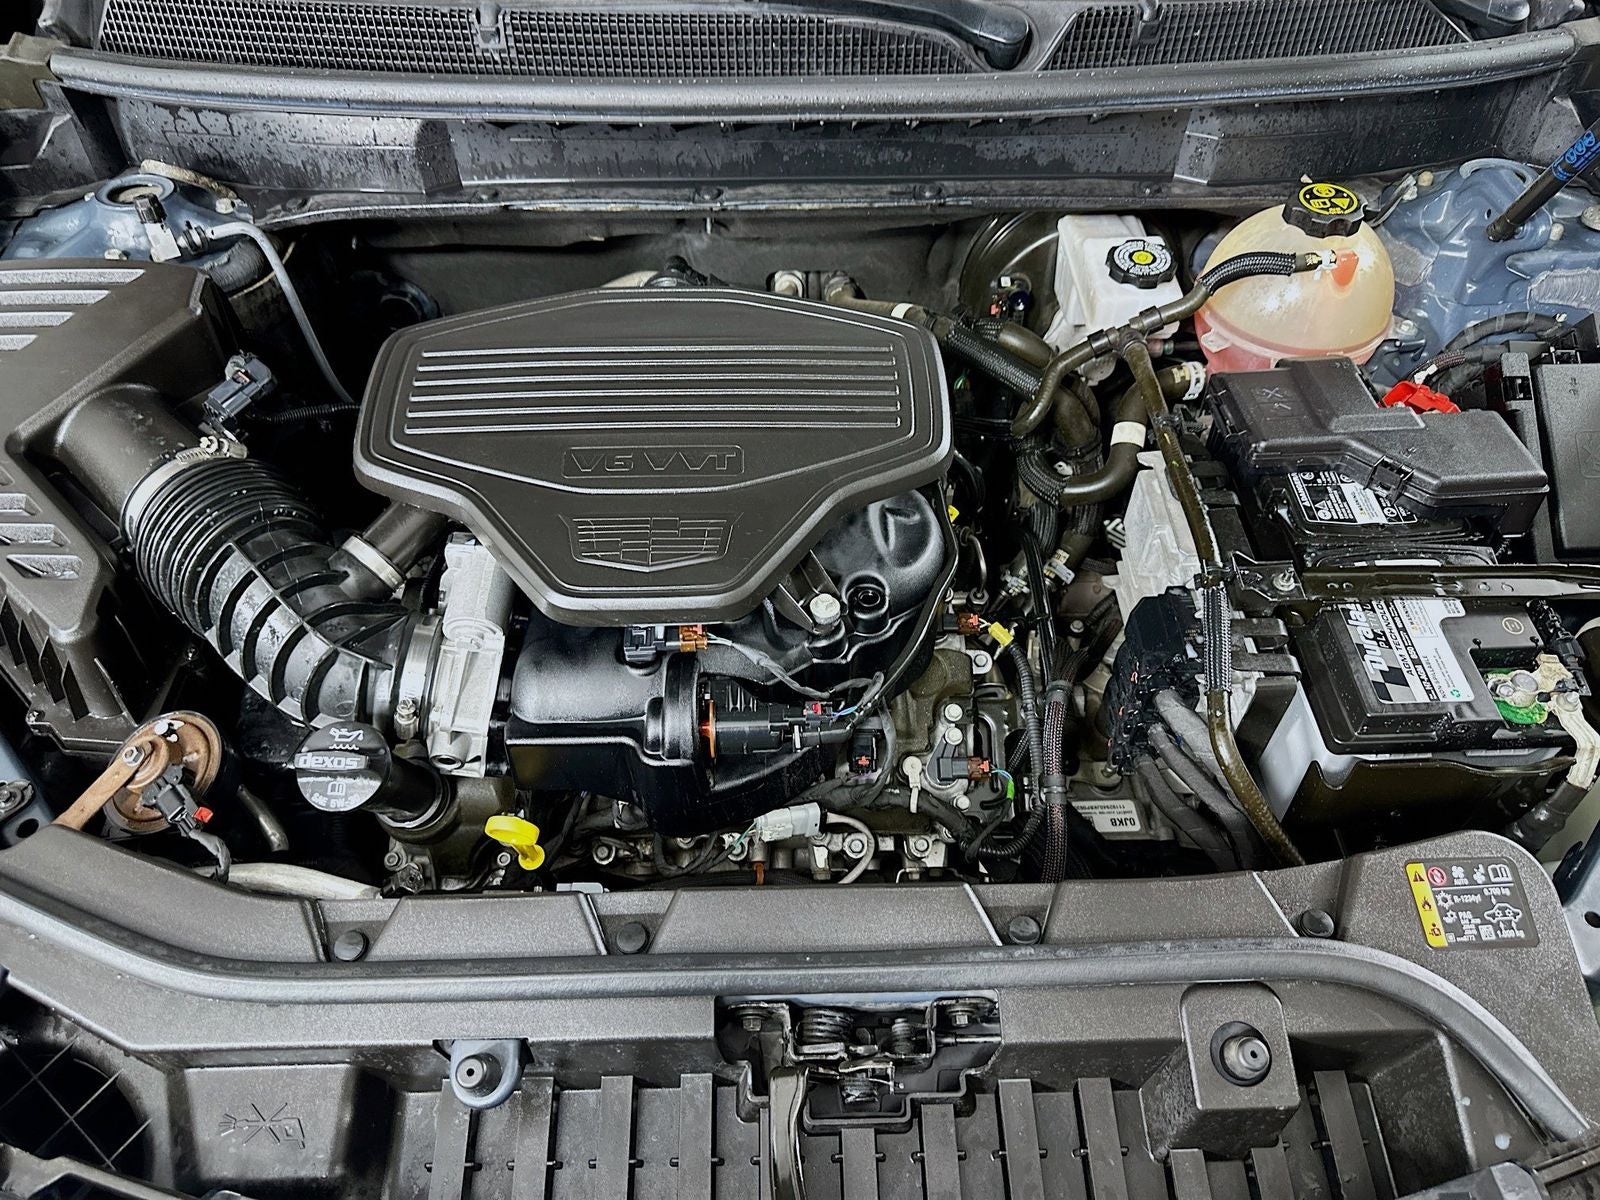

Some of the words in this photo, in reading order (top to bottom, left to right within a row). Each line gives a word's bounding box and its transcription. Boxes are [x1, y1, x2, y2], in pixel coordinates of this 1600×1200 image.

[571, 451, 634, 472] V6
[643, 451, 737, 472] VVT
[1363, 603, 1389, 649] PLATINU
[1376, 599, 1403, 652] TECHNOLO
[1345, 602, 1390, 675] Duralas
[1399, 654, 1415, 676] AGM
[298, 753, 361, 769] dexos
[311, 792, 329, 807] SAE
